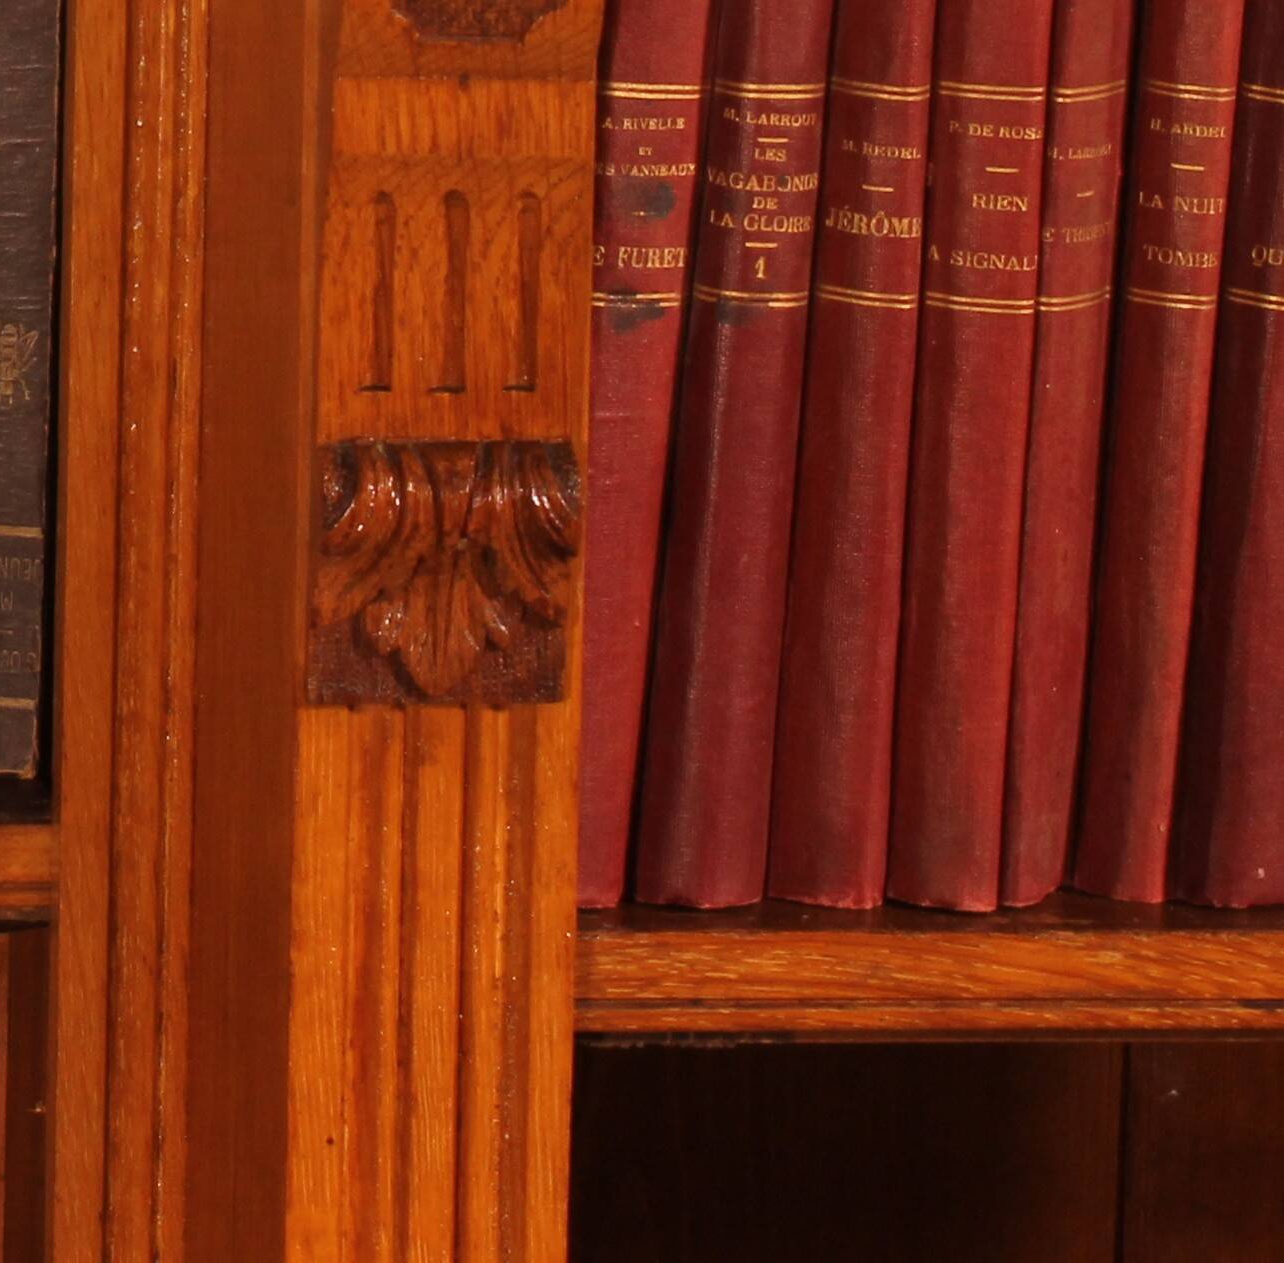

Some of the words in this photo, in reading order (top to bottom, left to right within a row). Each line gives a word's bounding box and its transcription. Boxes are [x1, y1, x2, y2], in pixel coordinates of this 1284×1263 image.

[623, 117, 685, 130] RIVELLE
[968, 123, 994, 137] DE
[638, 147, 652, 156] ET
[754, 147, 787, 162] LES
[752, 197, 778, 210] DE
[972, 193, 1029, 211] RIEN
[1138, 191, 1164, 210] LA
[1174, 196, 1225, 215] NUIT
[710, 210, 735, 228] LA
[743, 214, 811, 233] GLOIRE
[825, 205, 922, 238] JÉRÔME
[618, 246, 688, 269] FURET
[754, 256, 767, 279] 1
